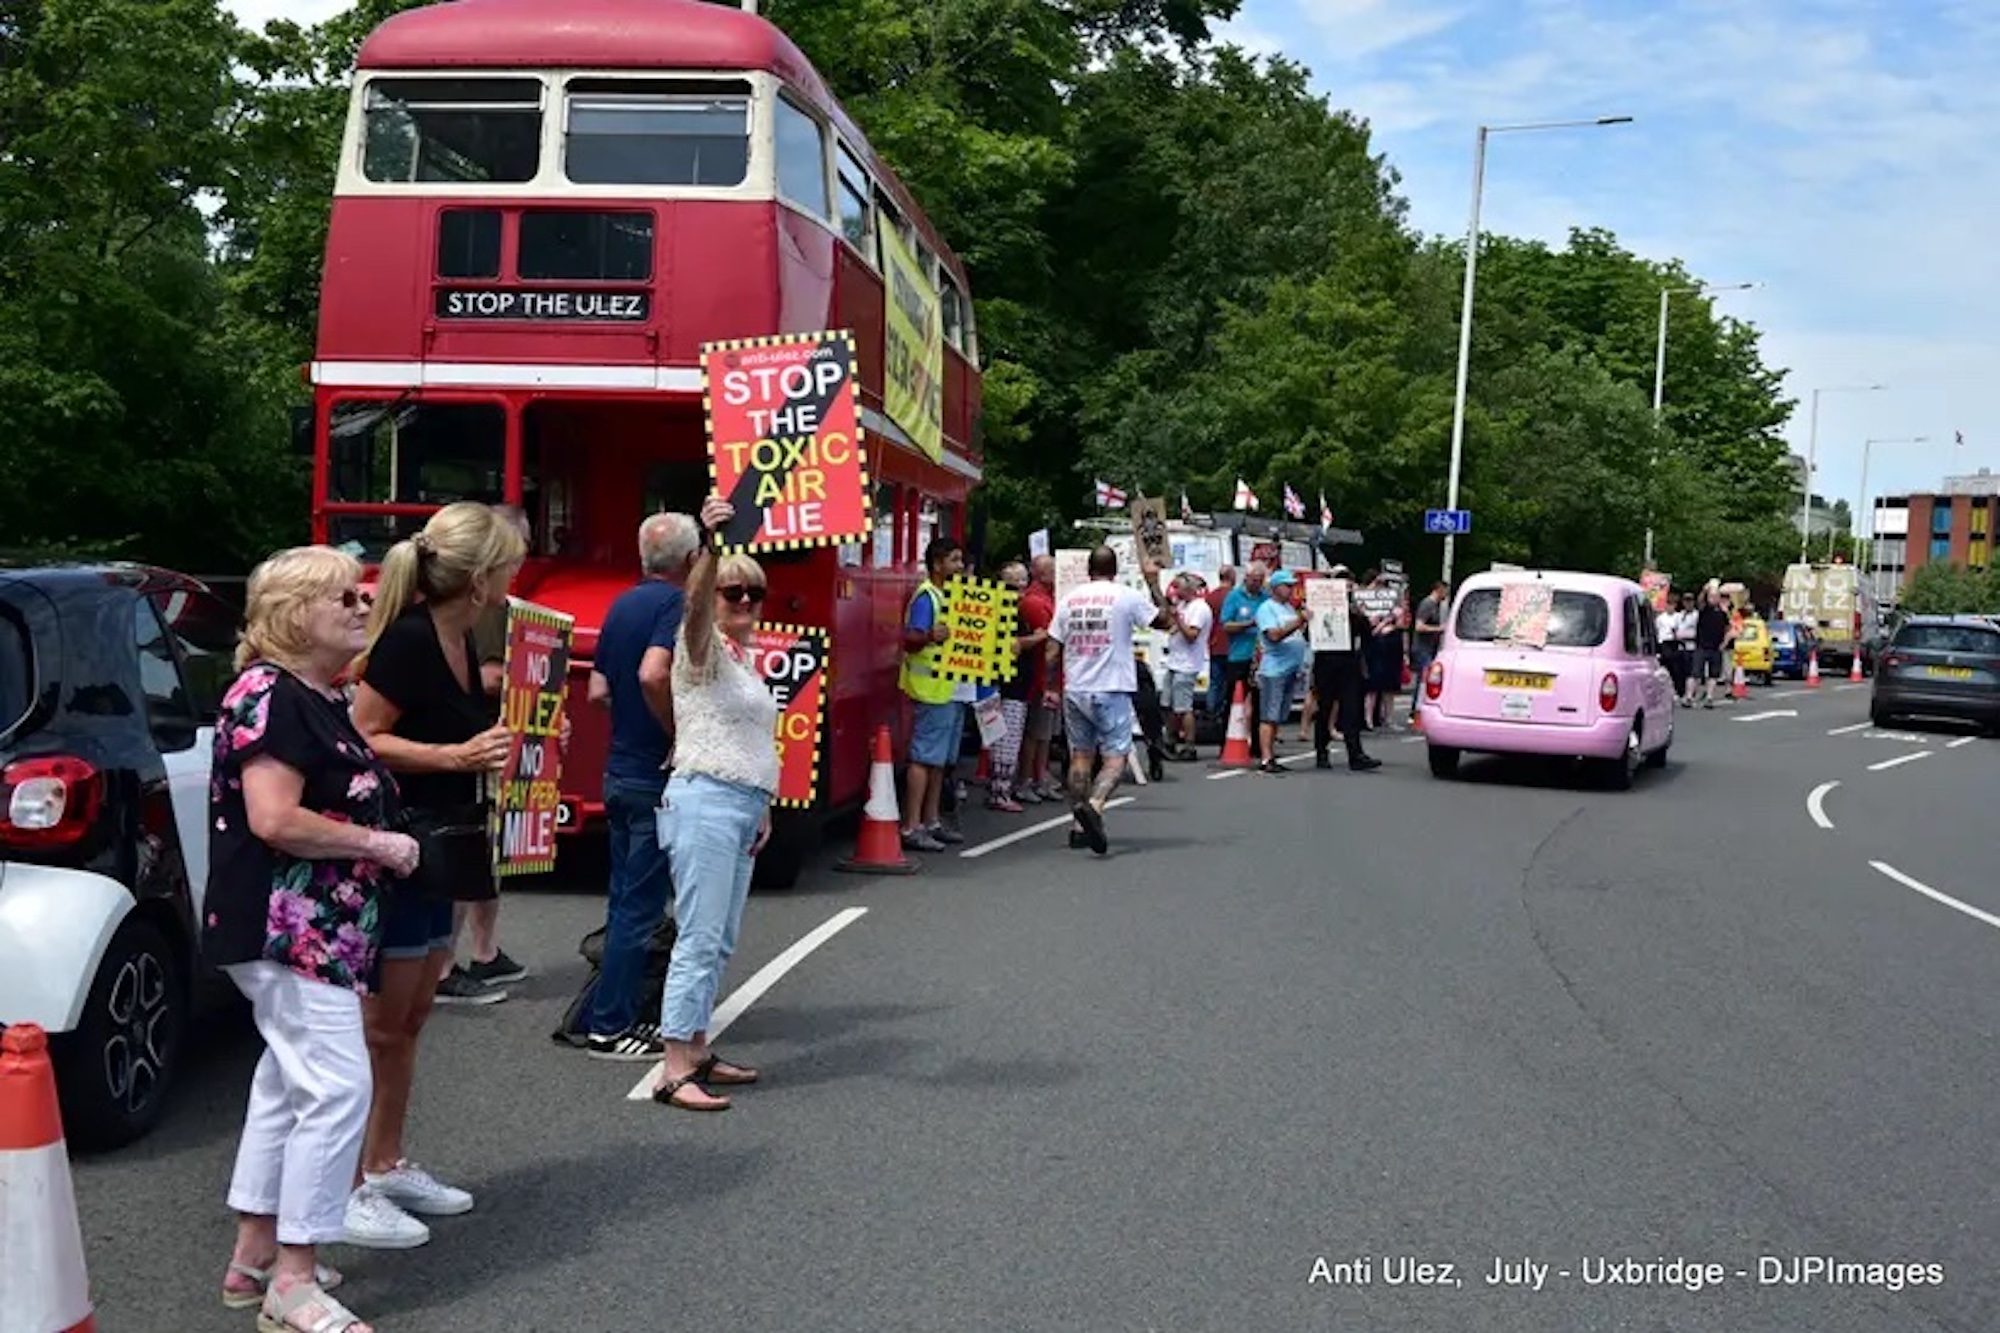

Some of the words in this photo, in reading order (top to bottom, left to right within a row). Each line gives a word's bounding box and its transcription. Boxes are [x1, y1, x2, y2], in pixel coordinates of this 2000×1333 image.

[449, 292, 515, 315] STOP
[520, 293, 569, 315] THE
[575, 295, 642, 316] ULEZ
[723, 362, 842, 404] STOP
[747, 405, 819, 437] THE
[723, 432, 850, 474] TOXIC
[755, 469, 826, 507] AIR
[763, 503, 824, 536] LIE
[954, 601, 993, 618] ULEZ
[963, 590, 990, 602] NO
[954, 629, 984, 642] PAY
[959, 617, 986, 629] NO
[745, 648, 816, 681] TOP
[948, 656, 985, 671] MILE
[953, 643, 982, 655] PER
[527, 652, 549, 685] NO
[508, 687, 562, 736] ULEZ
[520, 743, 544, 777] NO
[503, 779, 529, 808] PAY
[503, 810, 551, 858] MILE
